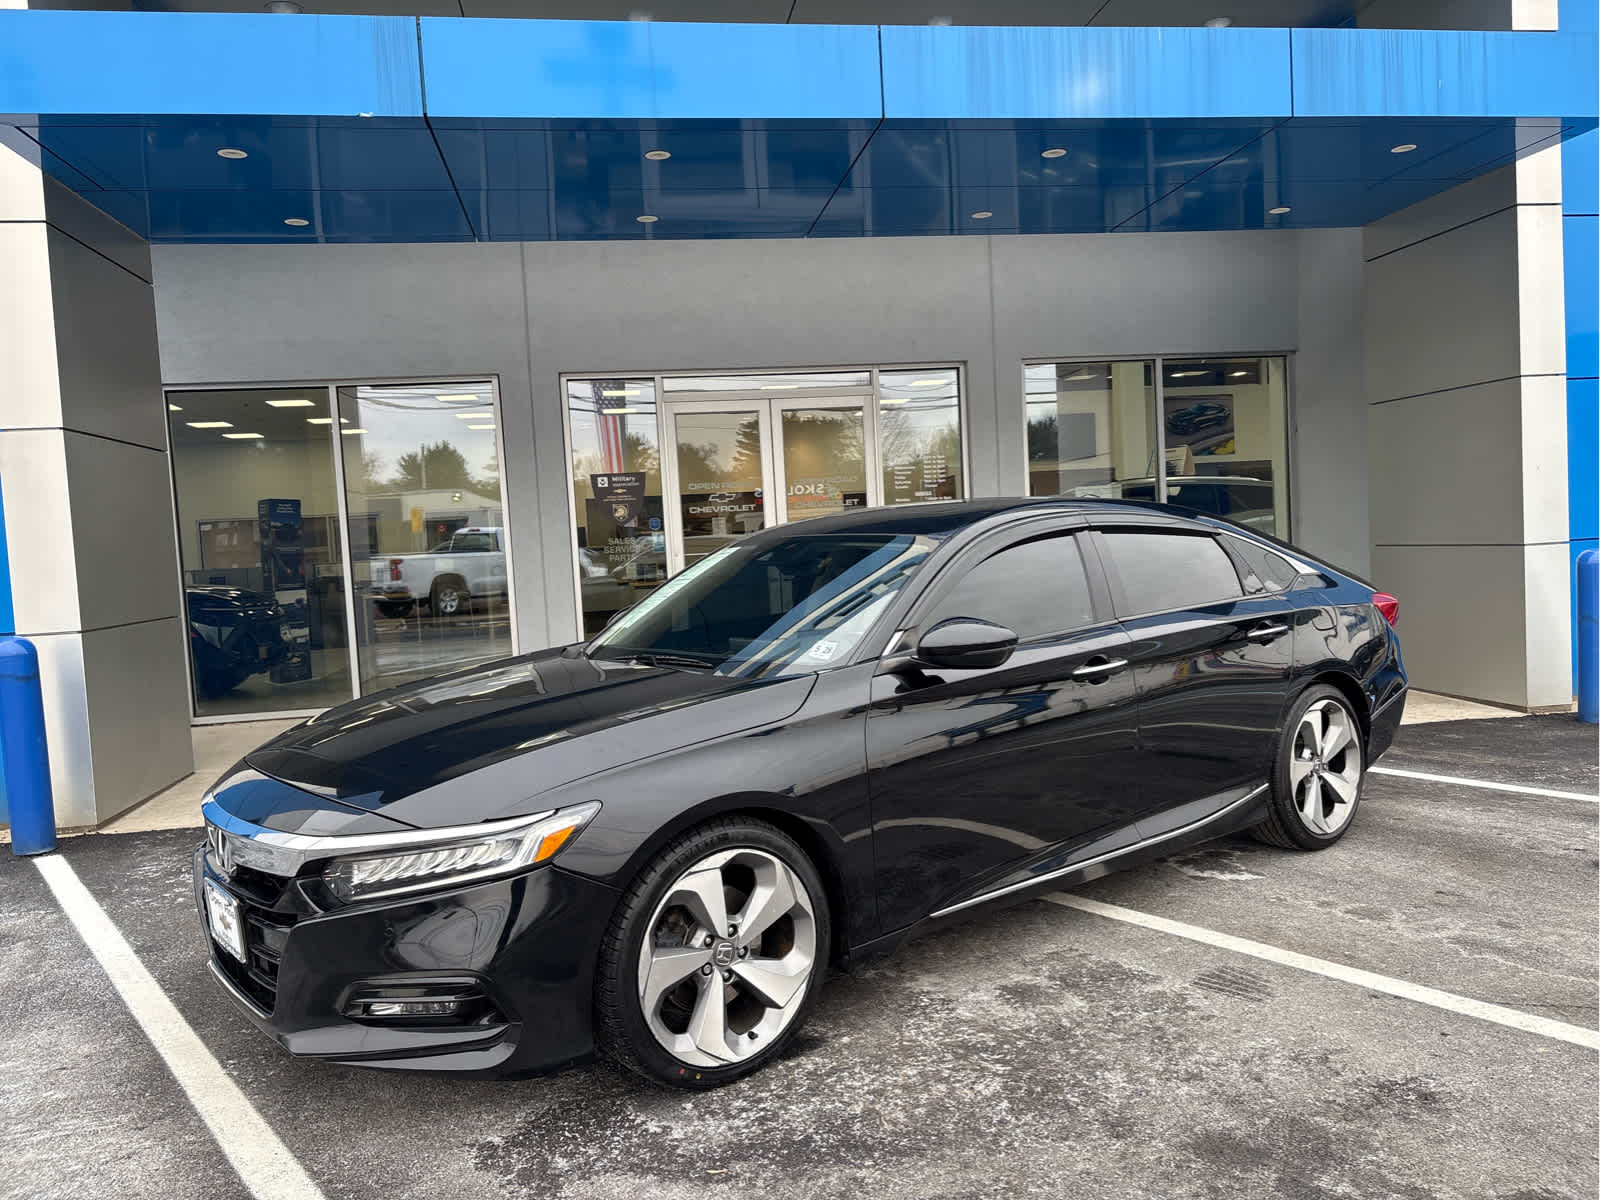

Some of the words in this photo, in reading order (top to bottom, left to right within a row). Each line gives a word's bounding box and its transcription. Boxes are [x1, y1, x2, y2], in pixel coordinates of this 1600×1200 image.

[687, 482, 720, 490] OPEN
[688, 504, 757, 514] CHEVROLET
[607, 536, 636, 546] SALES
